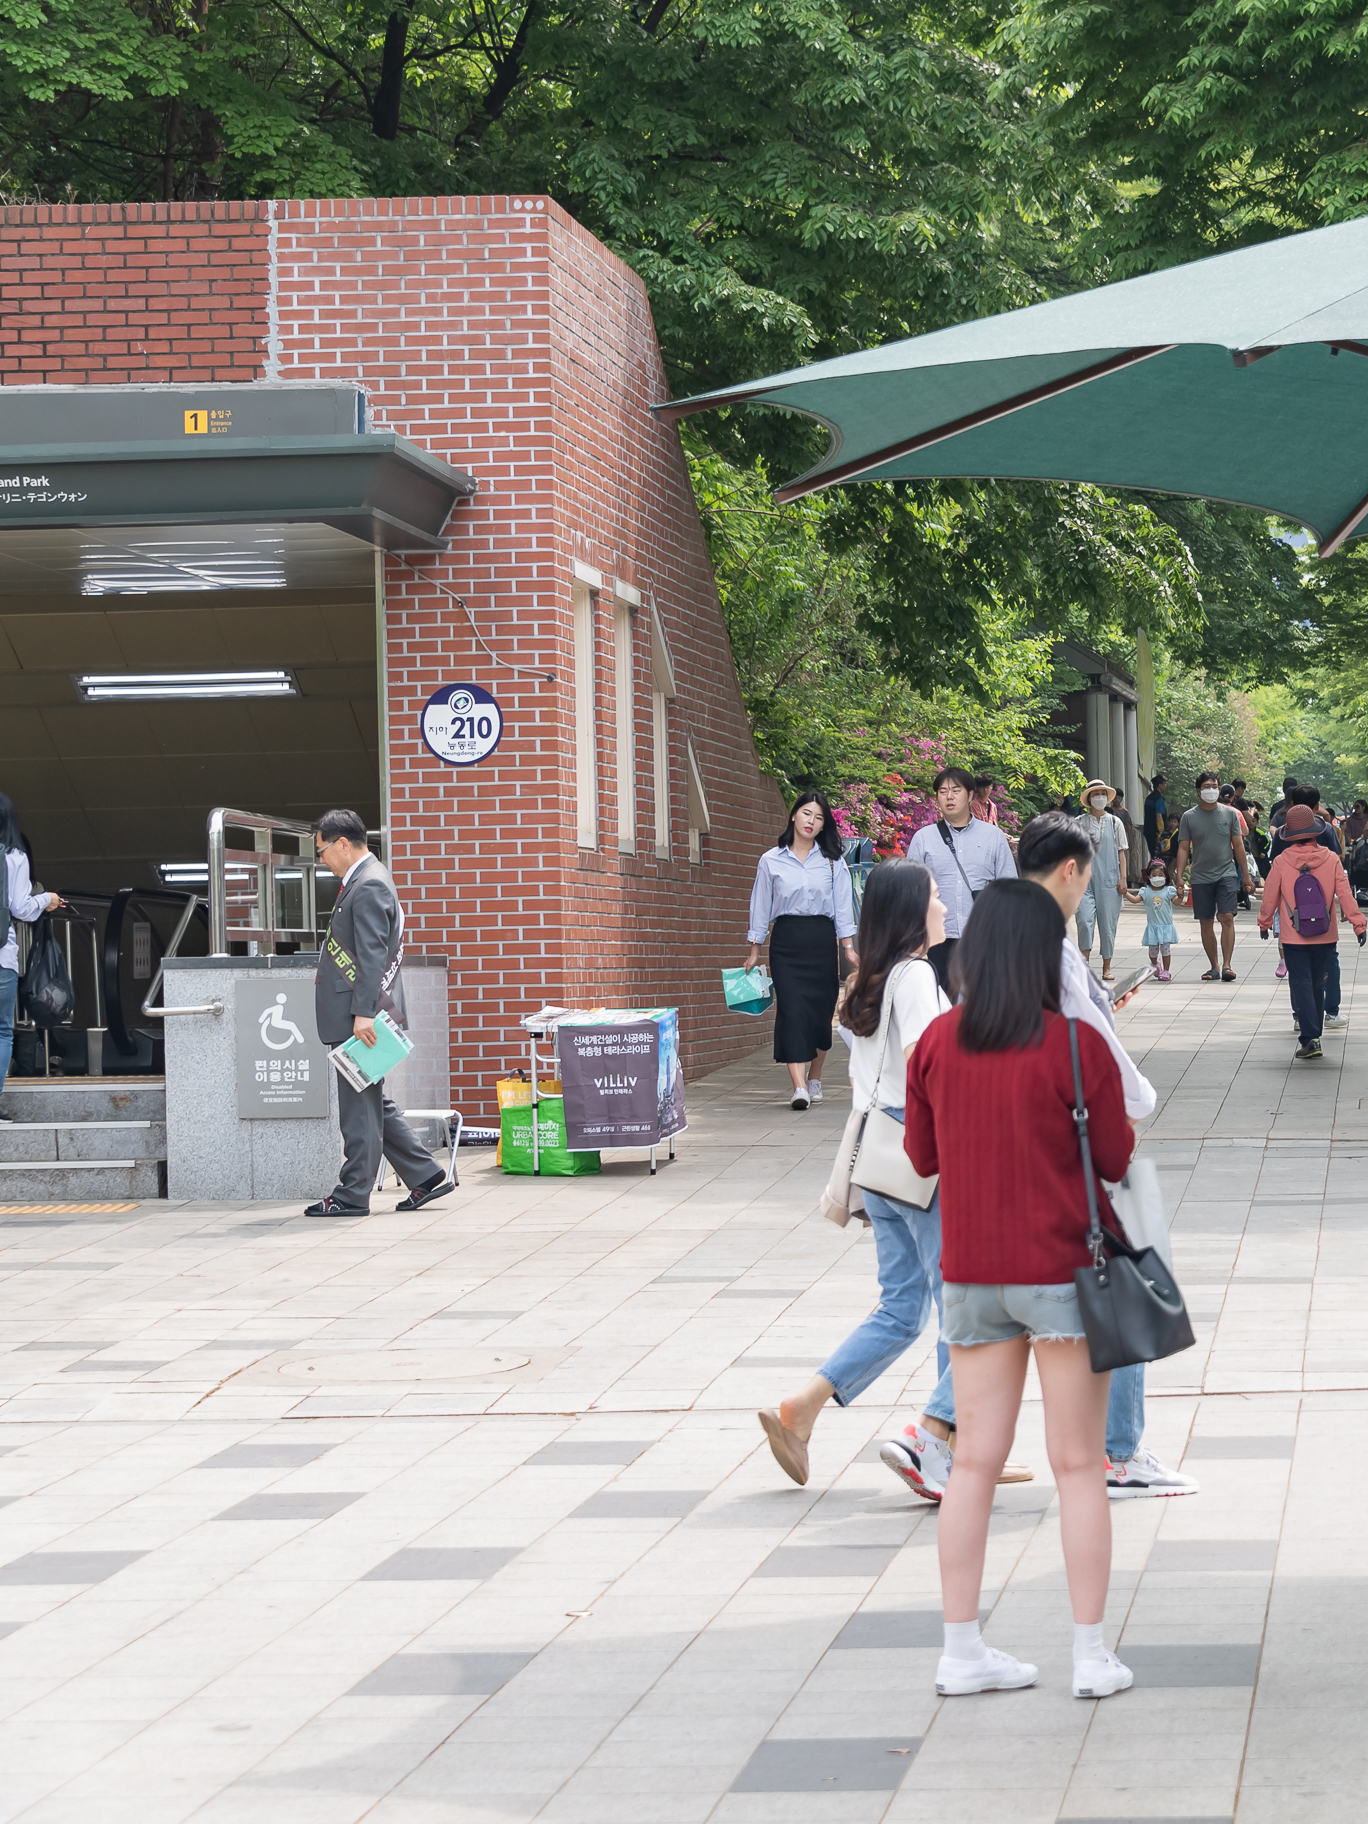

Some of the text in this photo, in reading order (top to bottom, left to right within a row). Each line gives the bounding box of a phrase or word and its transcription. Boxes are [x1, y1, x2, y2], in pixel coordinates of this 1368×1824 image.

[210, 410, 232, 419] 출입구
[190, 413, 198, 431] 1
[22, 475, 50, 487] Park
[450, 715, 493, 740] 210
[447, 740, 477, 751] 능동로
[573, 1032, 655, 1046] 신세계건설이 시공하는
[604, 1044, 651, 1056] 테라스라이프
[254, 1059, 310, 1071] 편의시설
[255, 1071, 310, 1082] 이용안내
[594, 1073, 638, 1088] VILLIV
